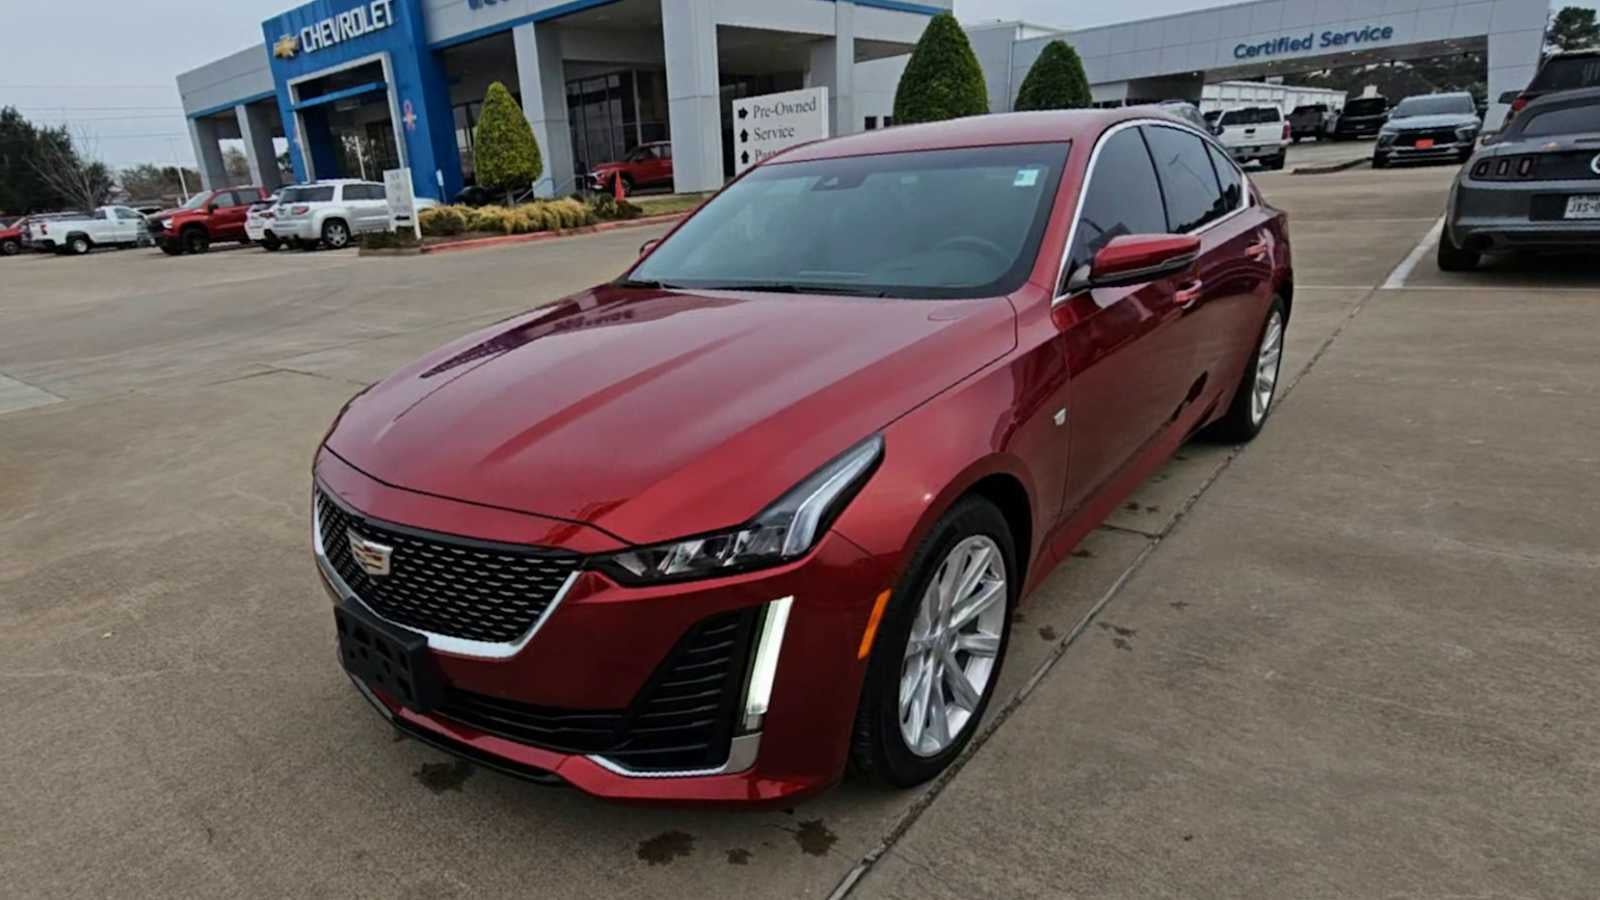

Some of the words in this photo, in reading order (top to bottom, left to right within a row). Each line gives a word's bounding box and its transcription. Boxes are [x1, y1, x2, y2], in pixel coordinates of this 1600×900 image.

[301, 0, 393, 53] CHEVROLET
[1233, 33, 1314, 59] Certified
[1320, 25, 1393, 48] Service
[753, 96, 816, 119] Pre-Owned
[754, 127, 795, 141] Service
